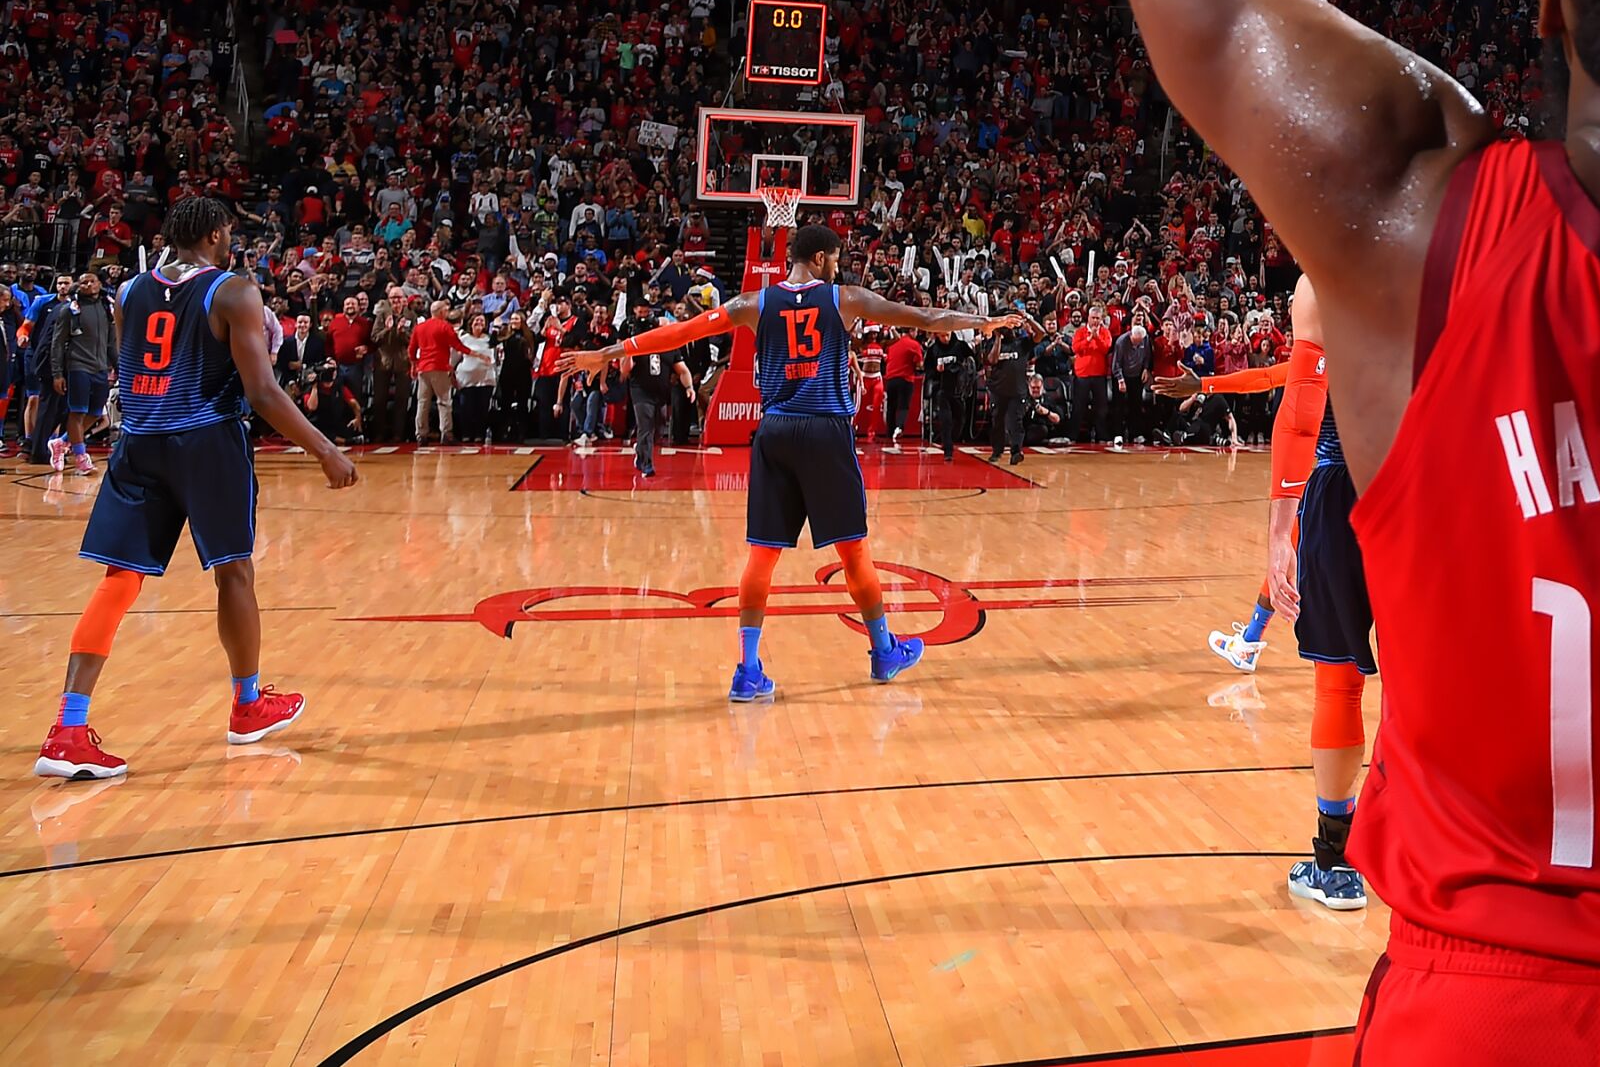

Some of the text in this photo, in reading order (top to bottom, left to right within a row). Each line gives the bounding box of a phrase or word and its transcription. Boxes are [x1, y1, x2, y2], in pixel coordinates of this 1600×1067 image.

[773, 8, 802, 28] 0.0
[770, 66, 817, 77] TISSOT
[144, 311, 176, 370] 9
[780, 307, 823, 360] 13
[719, 403, 752, 420] HAPPY
